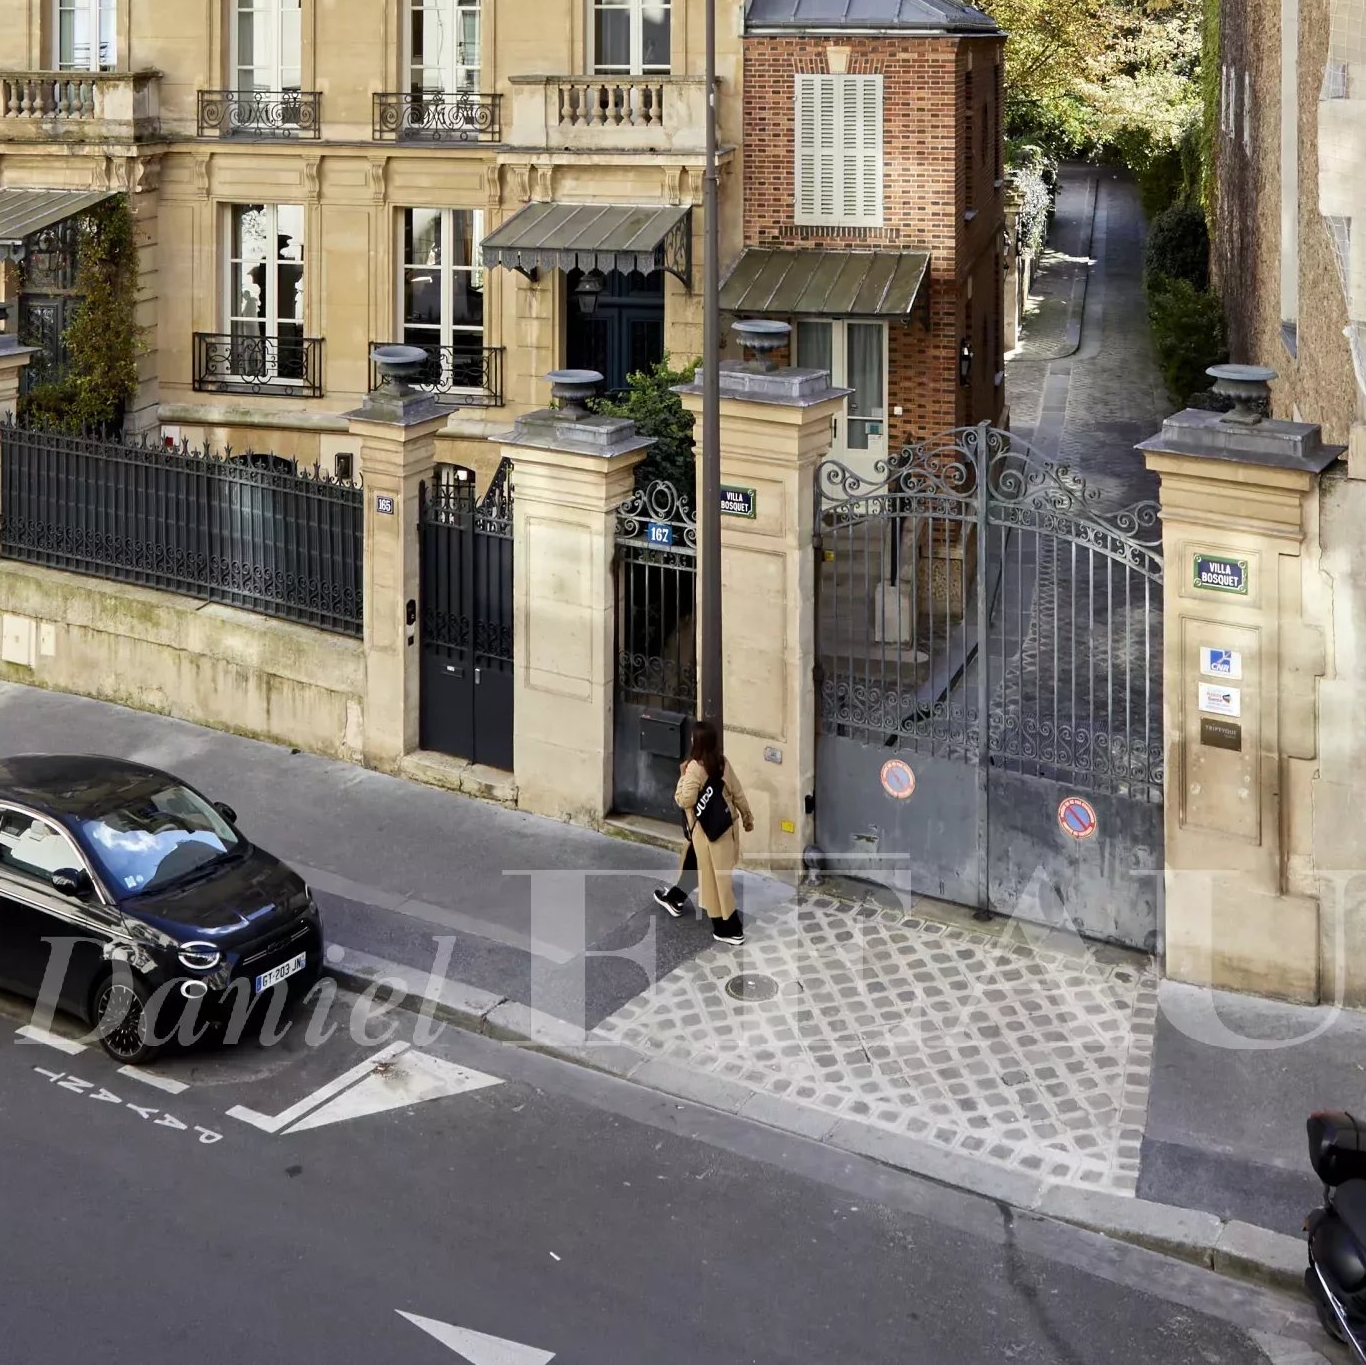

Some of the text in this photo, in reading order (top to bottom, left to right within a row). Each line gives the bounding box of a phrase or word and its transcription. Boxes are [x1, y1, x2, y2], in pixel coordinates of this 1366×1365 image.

[726, 491, 743, 502] VILLA
[378, 498, 391, 512] 165
[721, 500, 749, 513] BOSQUET
[651, 526, 669, 543] 167
[1209, 561, 1232, 575] VILLA
[1201, 571, 1239, 587] BOSQUET
[1211, 662, 1231, 674] CNR
[696, 786, 713, 817] JUDO
[34, 1066, 223, 1143] PAYANT
